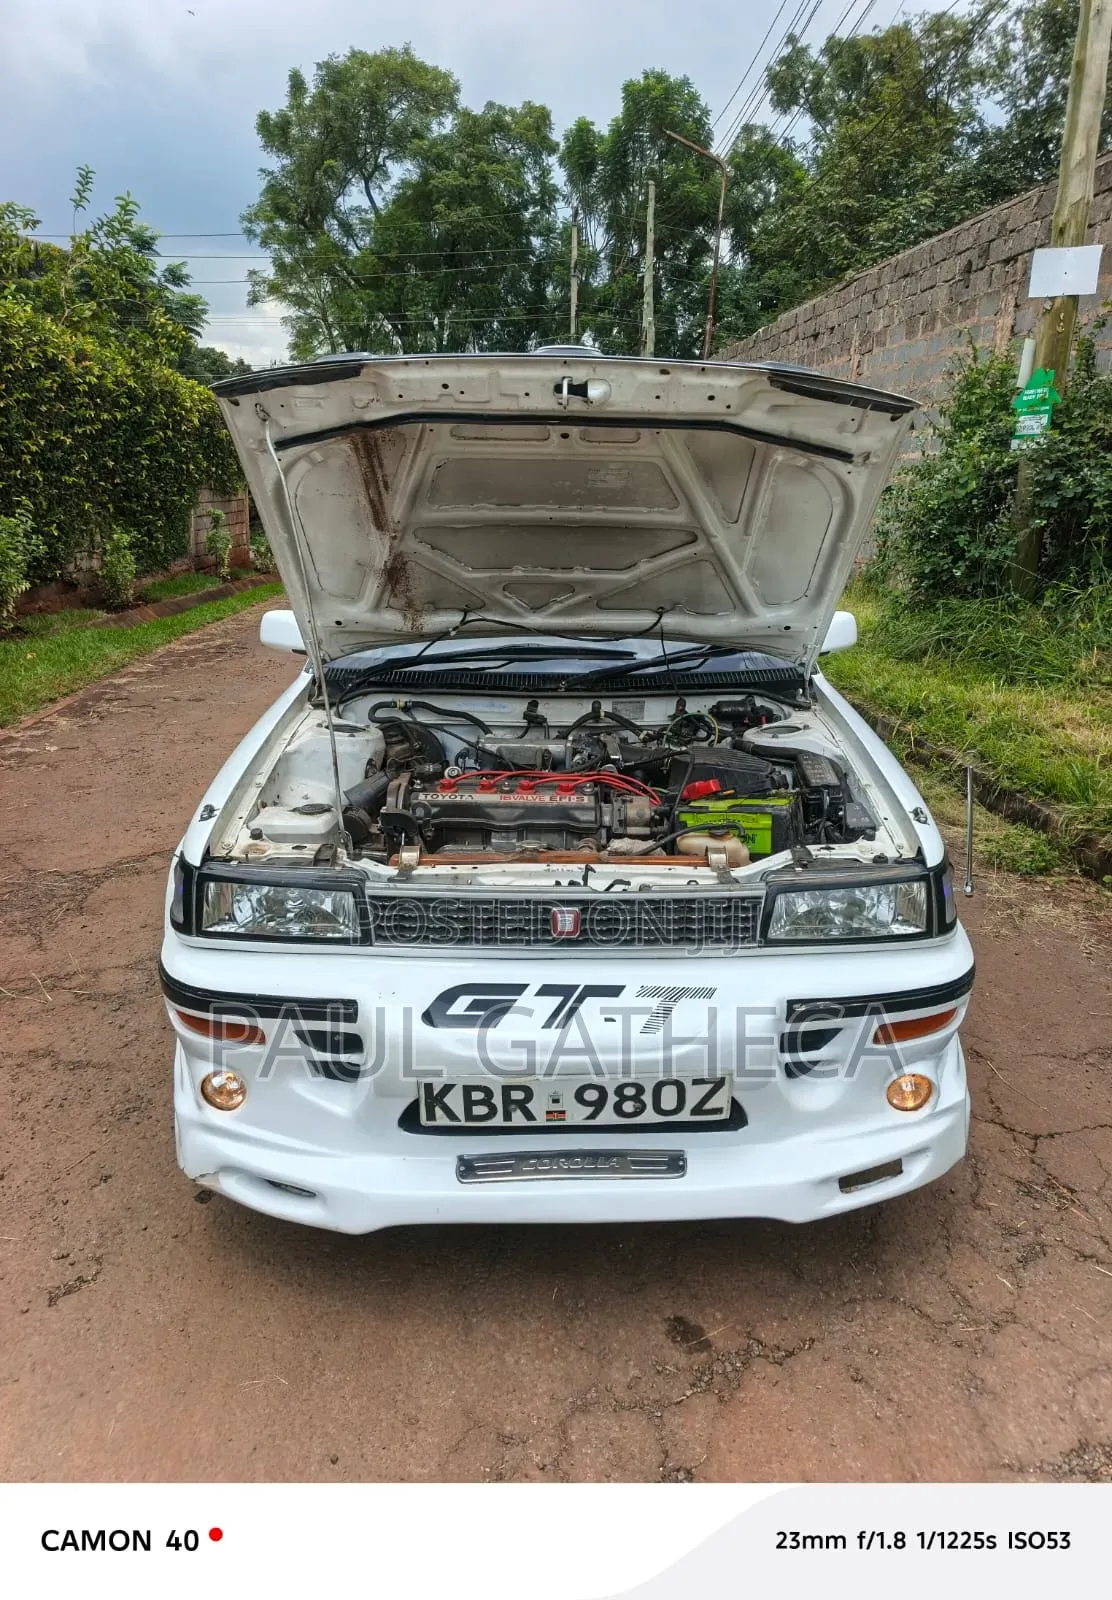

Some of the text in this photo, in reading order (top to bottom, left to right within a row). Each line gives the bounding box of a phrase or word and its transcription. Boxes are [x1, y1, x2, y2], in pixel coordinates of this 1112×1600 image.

[423, 793, 474, 801] TOYOTA
[422, 1076, 727, 1123] KBR 980Z
[520, 1156, 621, 1171] COROLLA
